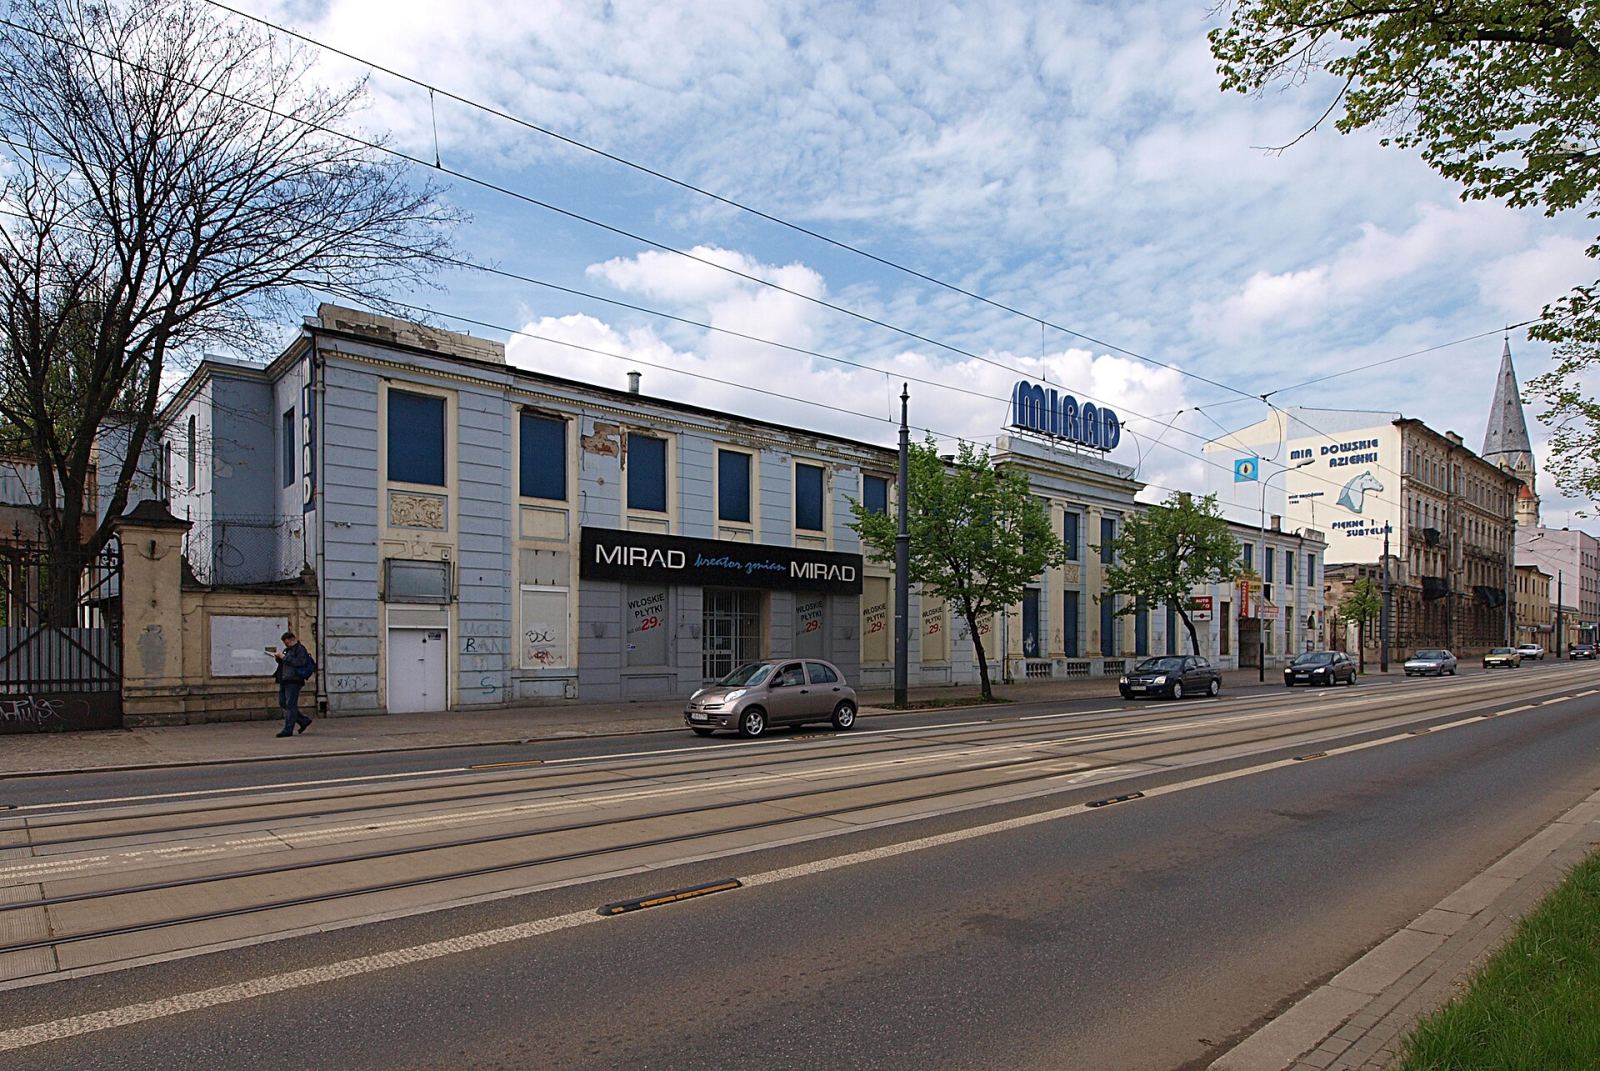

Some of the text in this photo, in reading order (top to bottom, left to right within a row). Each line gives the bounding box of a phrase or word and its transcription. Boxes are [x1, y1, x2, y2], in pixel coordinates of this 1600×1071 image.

[1012, 380, 1120, 449] MIRAD
[595, 544, 856, 582] MIRAD kreator zmian MIRAD
[628, 593, 665, 609] WŁOSKIE
[635, 605, 663, 618] PŁYTKI
